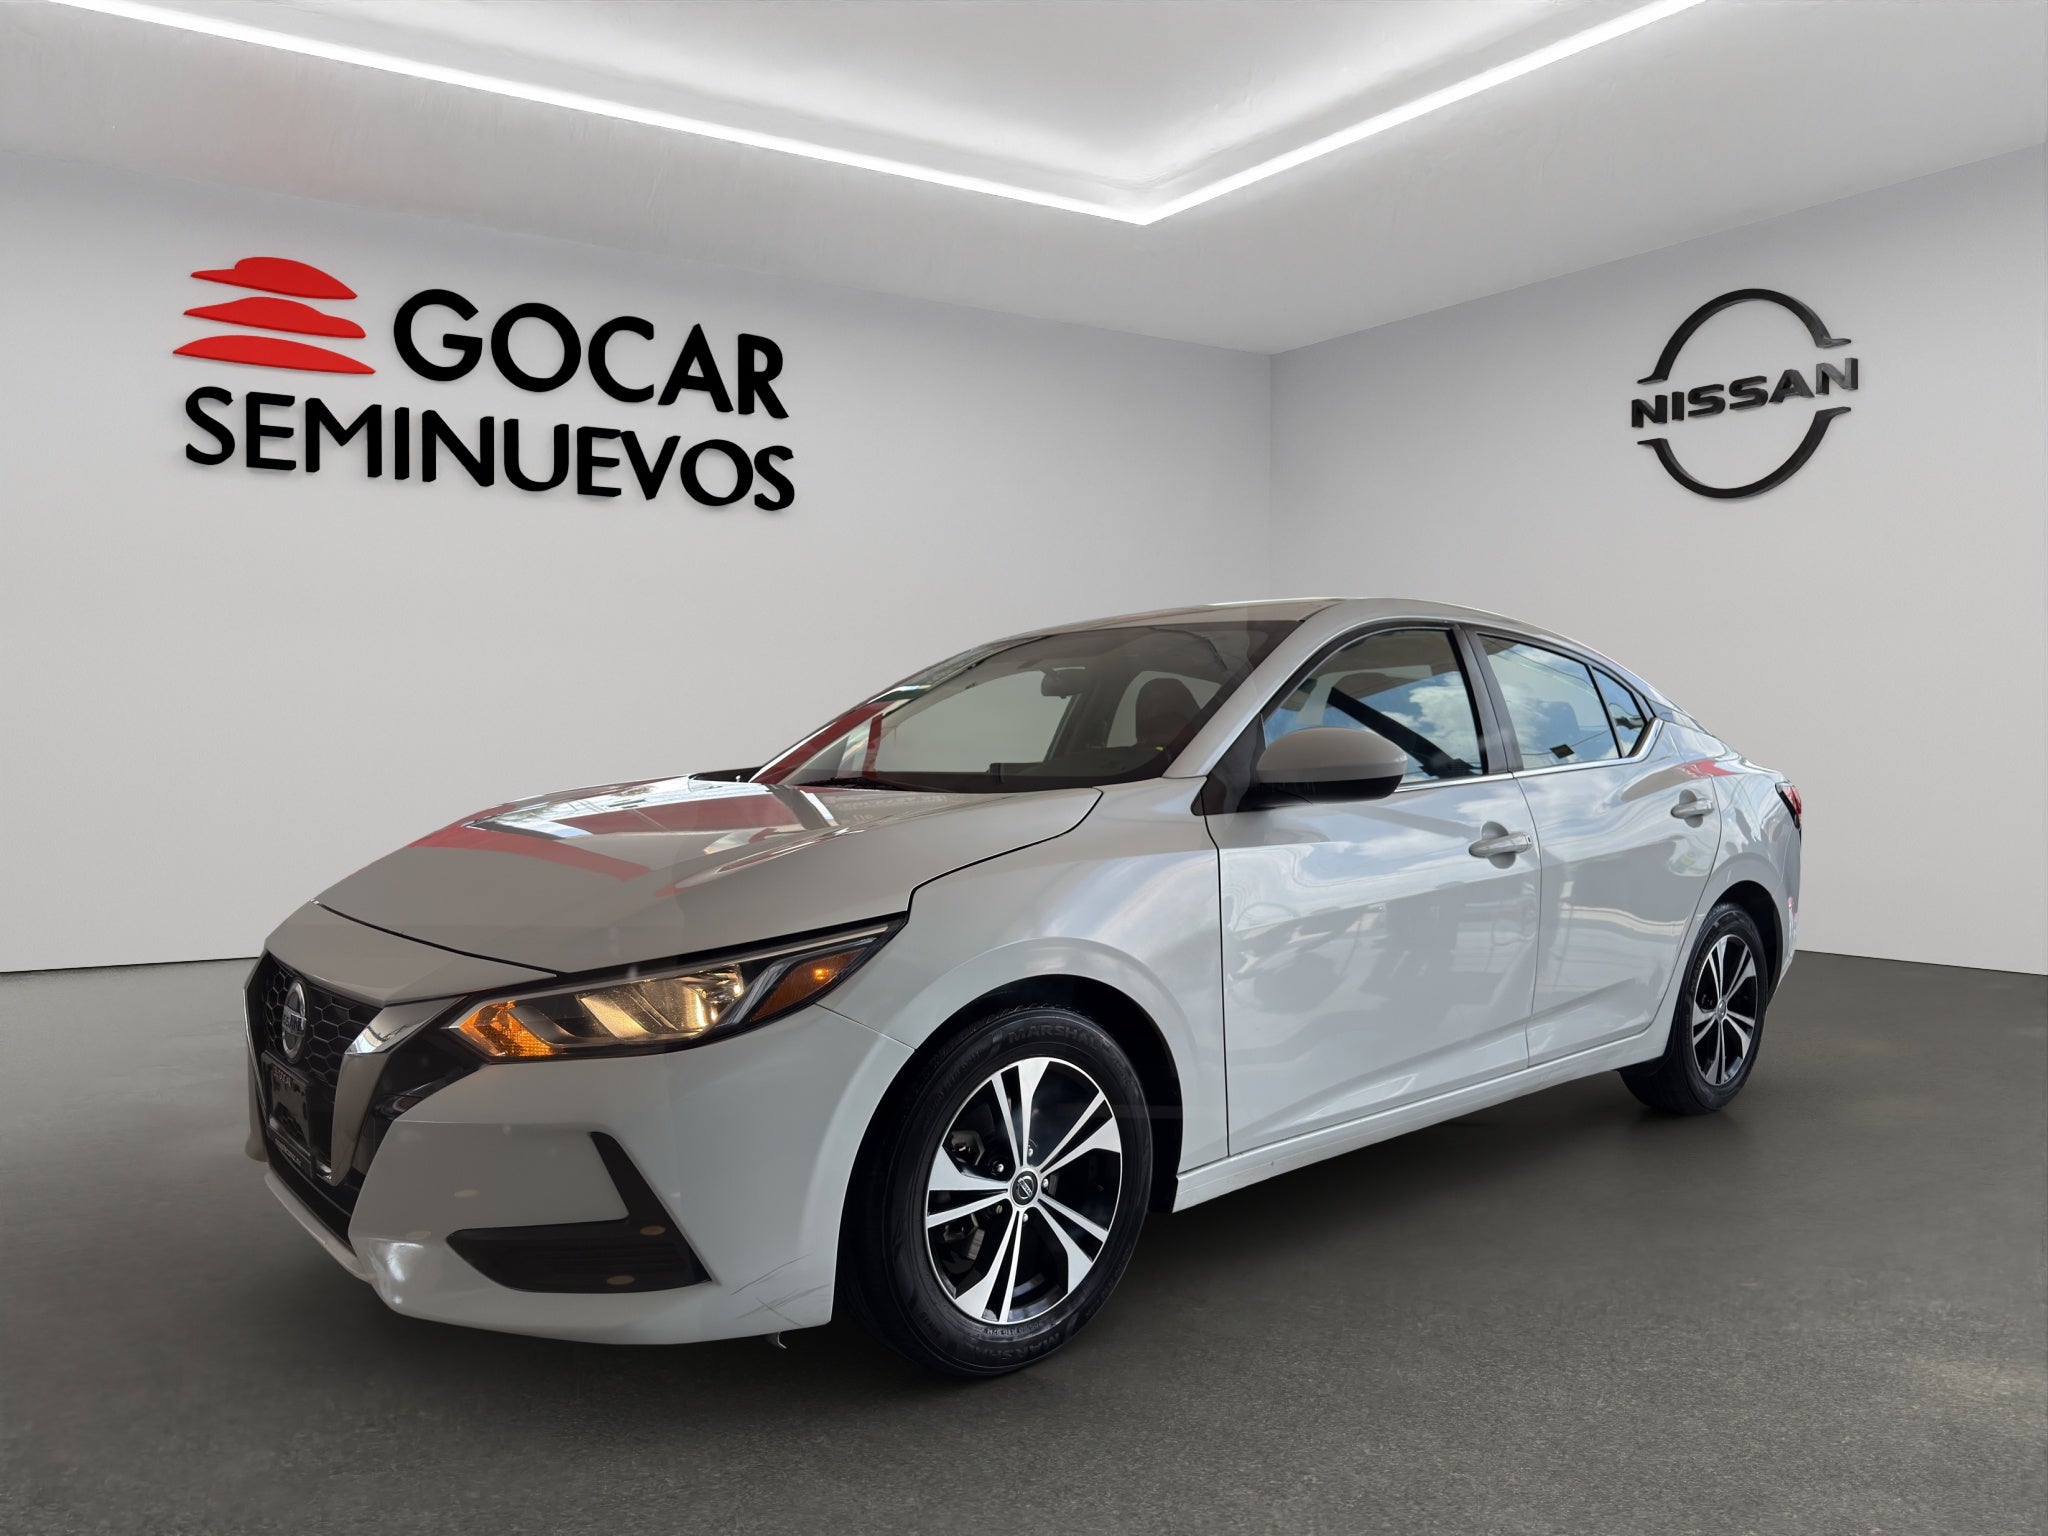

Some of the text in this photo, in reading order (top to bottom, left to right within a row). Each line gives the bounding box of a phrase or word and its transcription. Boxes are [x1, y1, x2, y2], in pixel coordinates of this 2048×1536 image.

[394, 289, 789, 420] GOCAR
[1631, 357, 1858, 428] NISSAN
[185, 386, 795, 512] SEMINUEVOS
